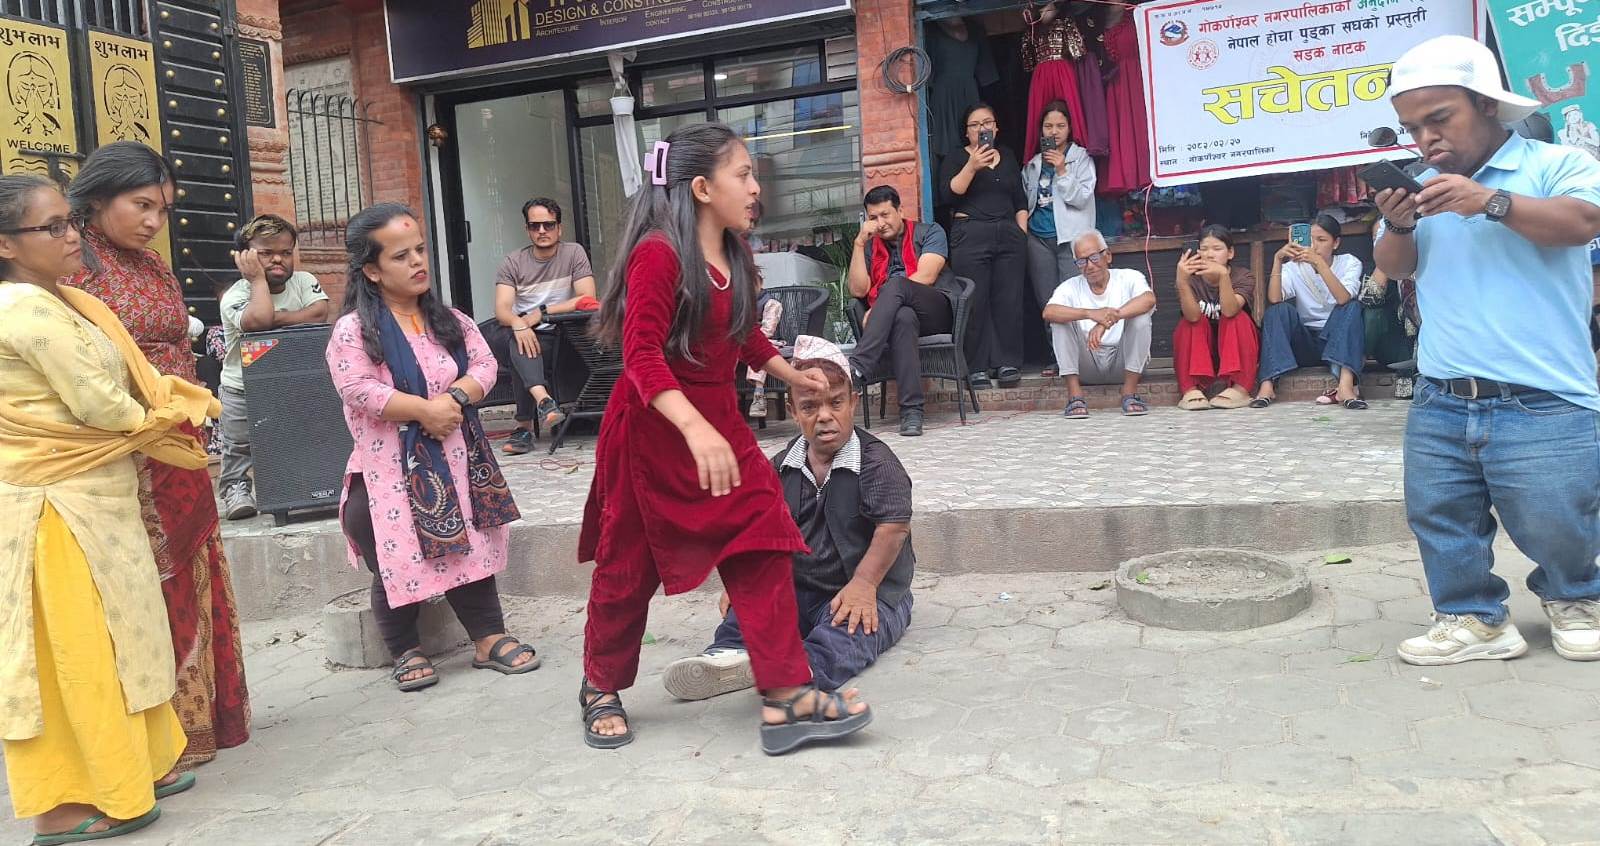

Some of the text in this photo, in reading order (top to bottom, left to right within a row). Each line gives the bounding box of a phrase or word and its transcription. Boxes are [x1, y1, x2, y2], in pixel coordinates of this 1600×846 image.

[535, 7, 587, 26] DESIGN
[590, 3, 600, 16] &
[0, 27, 60, 49] शुभ लाभ
[535, 25, 580, 37] ARCHITECTURE
[1226, 36, 1261, 50] नेपाल
[1265, 30, 1294, 46] होचा
[1385, 7, 1428, 28] प्रस्तुती
[94, 40, 149, 61] शुभ लाभ
[1293, 41, 1367, 62] सडक नाटक
[7, 139, 70, 154] WELCOME
